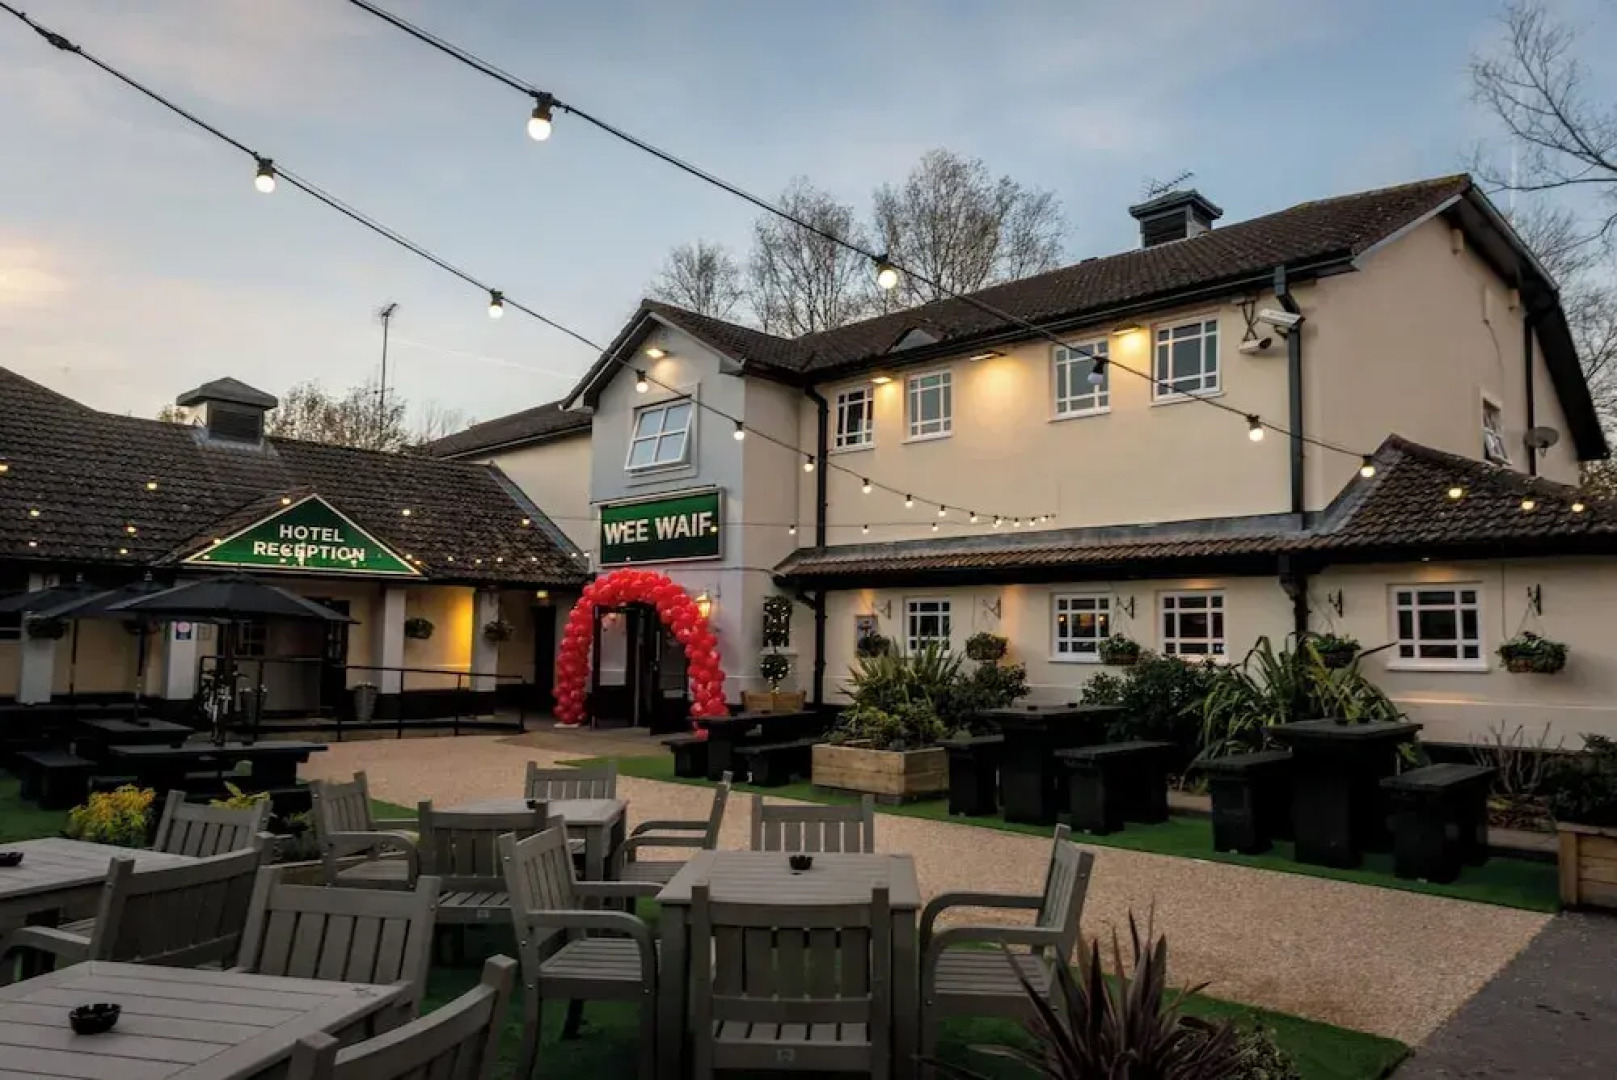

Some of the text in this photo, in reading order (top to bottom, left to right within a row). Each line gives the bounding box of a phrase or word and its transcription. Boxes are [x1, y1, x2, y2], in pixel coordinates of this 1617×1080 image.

[279, 524, 344, 542] HOTEL
[604, 511, 712, 545] WEE WAIF
[253, 541, 365, 561] RECEPTION
